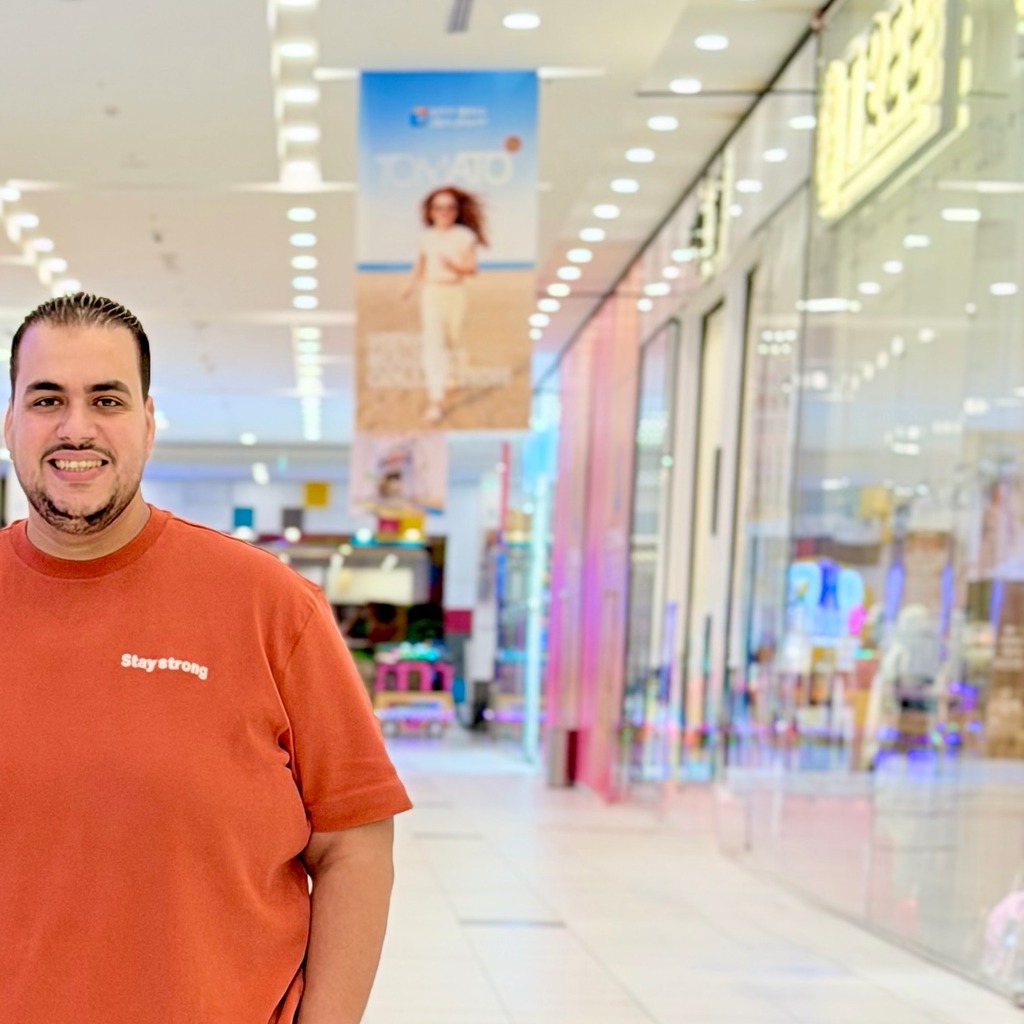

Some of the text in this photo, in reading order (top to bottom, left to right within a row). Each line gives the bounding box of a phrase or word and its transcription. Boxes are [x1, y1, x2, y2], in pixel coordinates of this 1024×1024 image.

[374, 151, 512, 188] TOMATO
[120, 653, 209, 680] Stay strong
